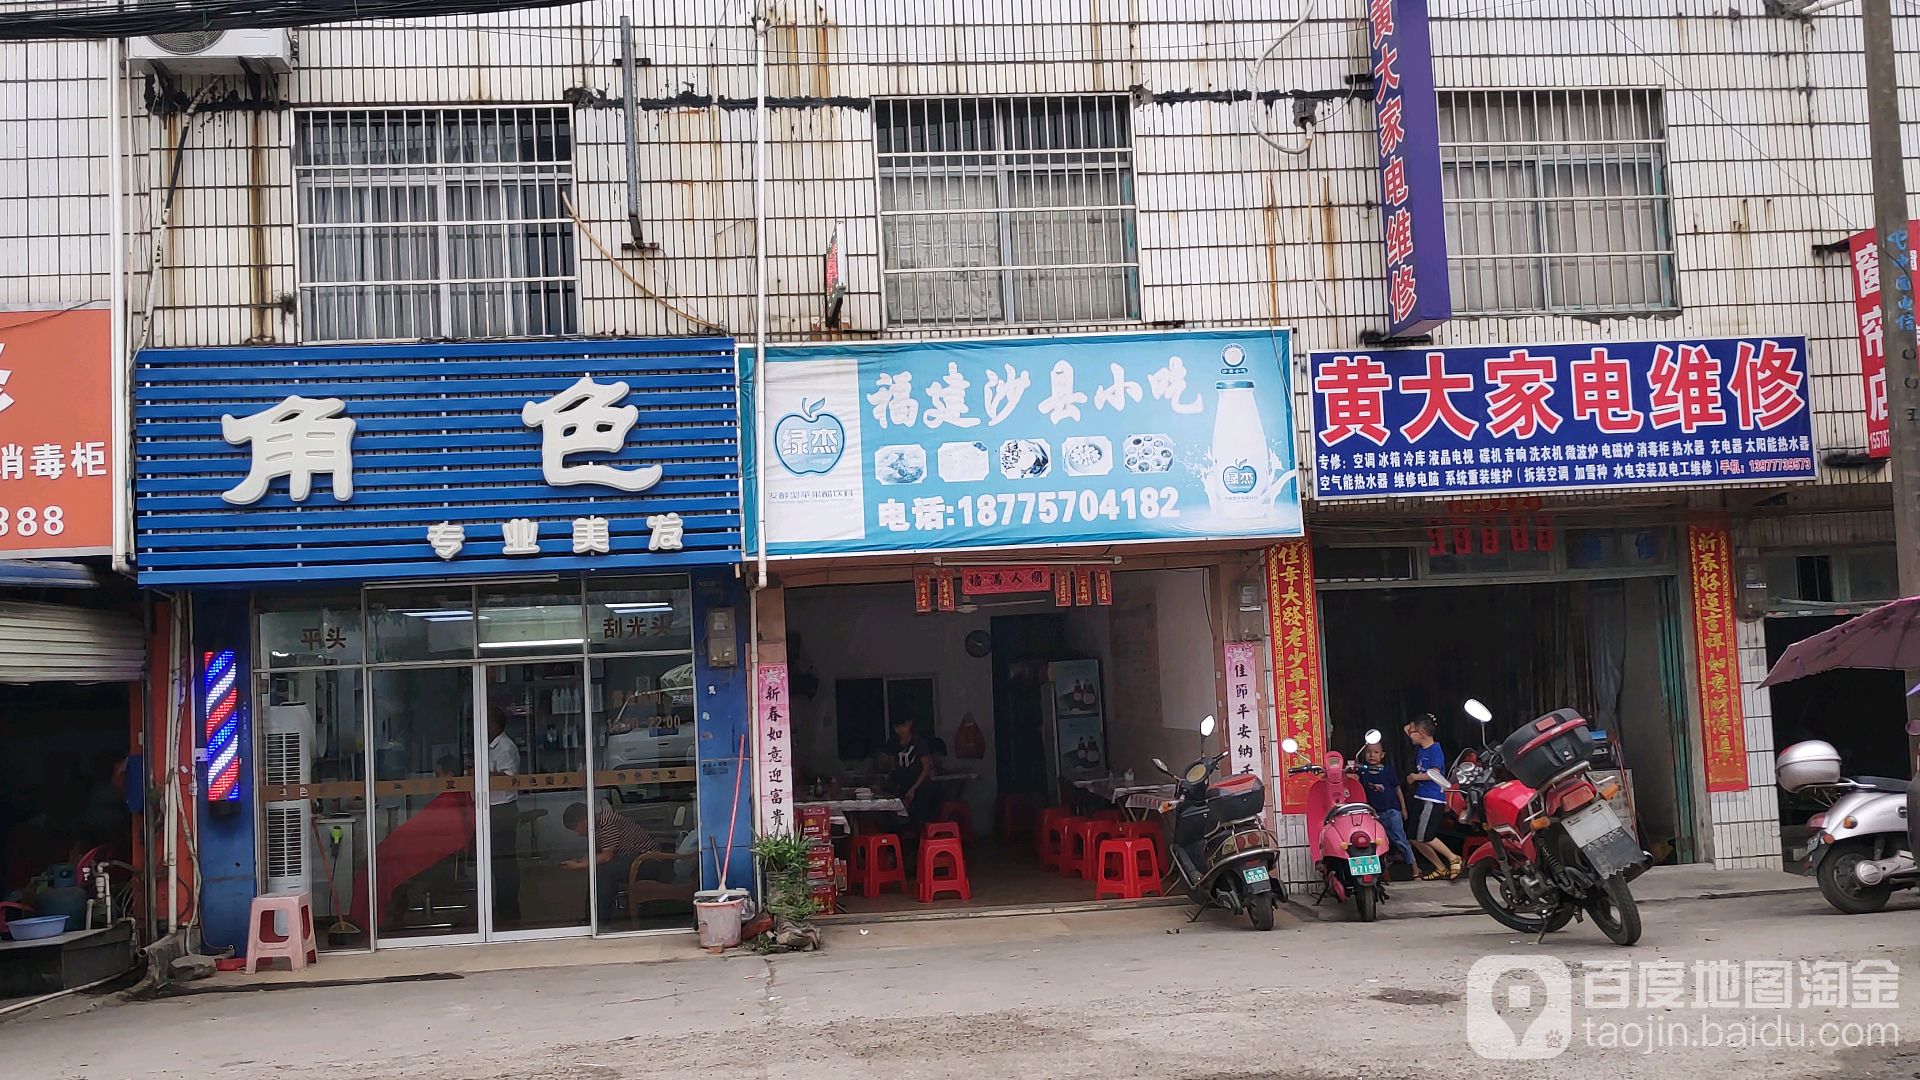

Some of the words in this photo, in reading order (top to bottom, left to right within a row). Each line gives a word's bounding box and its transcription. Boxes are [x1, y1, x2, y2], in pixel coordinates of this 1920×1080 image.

[1369, 0, 1417, 326] 黄大家电维修
[866, 355, 1203, 430] 福建沙县小吃
[1314, 339, 1806, 447] 黄大家电维修
[221, 376, 663, 506] 角色
[782, 428, 839, 456] 绿杰
[1353, 452, 1376, 469] 空调
[1378, 451, 1401, 468] 冰箱
[1403, 450, 1426, 467] 冷库
[1429, 448, 1475, 467] 液晶电视
[1479, 448, 1503, 465] 碟机
[1505, 446, 1527, 464] 音响
[1529, 445, 1563, 463] 洗衣机
[1565, 443, 1598, 460] 微波炉
[1601, 441, 1634, 459] 电磁炉
[1637, 440, 1671, 458] 消毒柜
[1672, 439, 1705, 457] 热水器
[1710, 437, 1743, 455] 充电器
[1745, 435, 1810, 453] 太阳能热水器
[1319, 472, 1389, 491] 空气能热水器
[1394, 470, 1440, 489] 维修电脑
[1574, 463, 1608, 481] 加雪种
[878, 486, 1181, 532] 电话:18775704182
[427, 512, 684, 560] 专业美发
[300, 627, 347, 650] 平头
[603, 615, 674, 640] 刮光头
[765, 685, 785, 827] 新春如意迎富貴
